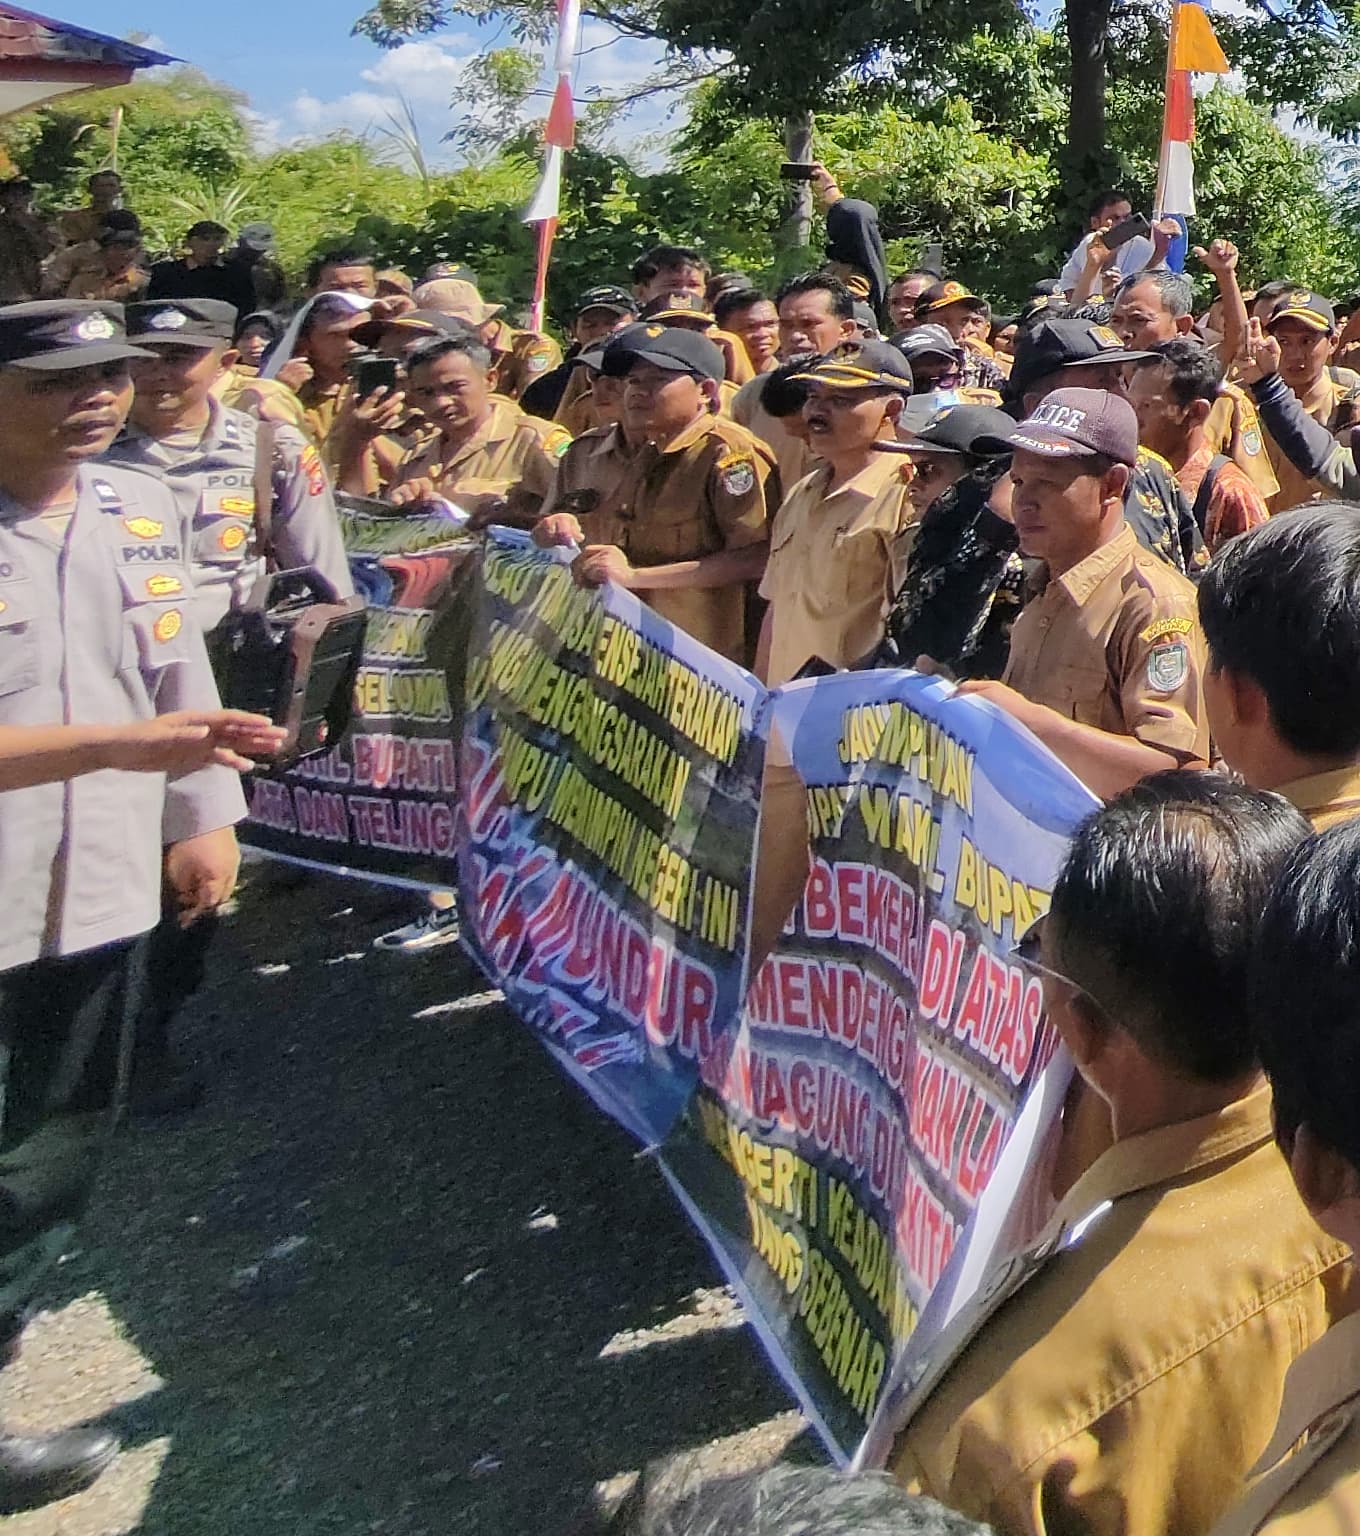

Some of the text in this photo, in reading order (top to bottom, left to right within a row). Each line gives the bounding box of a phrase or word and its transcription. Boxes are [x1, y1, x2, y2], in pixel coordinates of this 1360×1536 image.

[207, 475, 256, 488] POL
[122, 545, 180, 563] POLRI
[597, 615, 744, 768] ENSEJAHTERAKAN
[353, 733, 456, 792] BUPATI
[294, 785, 350, 843] DAN
[700, 875, 739, 952] INI
[954, 834, 1053, 942] BUPAT
[918, 919, 966, 1030] DI
[954, 945, 1043, 1087] ATAS
